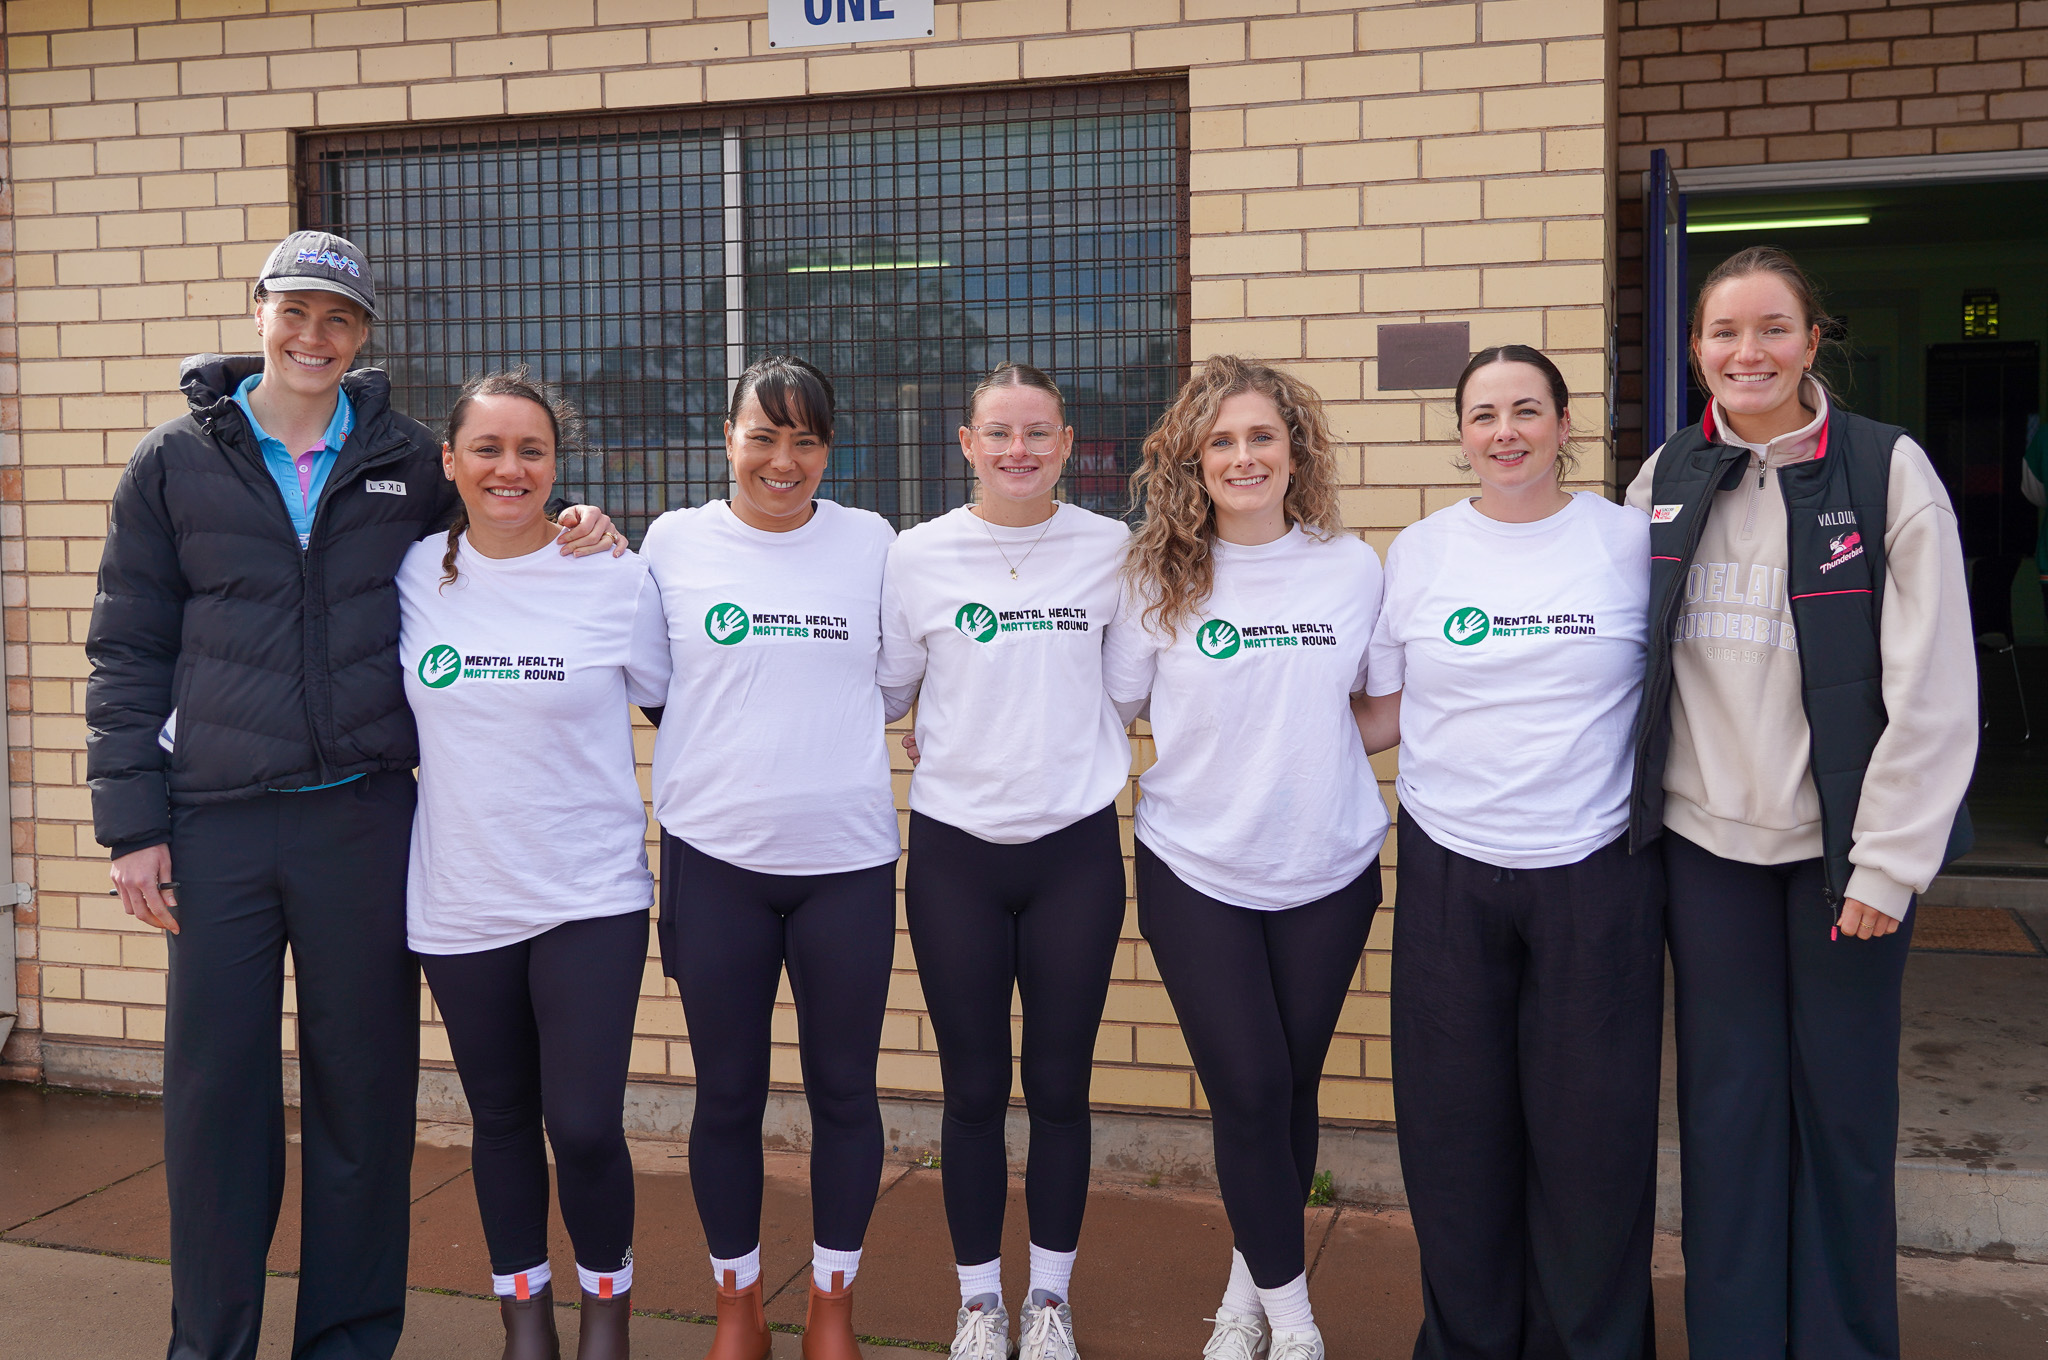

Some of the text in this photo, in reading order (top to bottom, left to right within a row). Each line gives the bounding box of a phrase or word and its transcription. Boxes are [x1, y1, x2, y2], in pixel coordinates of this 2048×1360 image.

[296, 248, 360, 278] MAVS
[1682, 562, 1791, 613] DELAI
[752, 613, 847, 628] MENTAL HEALTH
[999, 607, 1087, 621] MENTAL HEALTH
[1493, 613, 1594, 626] MENTAL HEALTH
[752, 625, 849, 641] MATTERS ROUND
[1000, 620, 1089, 633] MATTERS ROUND
[1242, 623, 1333, 637] MENTAL HEALTH
[1492, 625, 1596, 637] MATTERS ROUND
[1673, 612, 1797, 652] HUNDERBIR
[1243, 635, 1337, 649] MATTERS ROUND
[465, 655, 564, 668] MENTAL HEALTH
[1706, 646, 1766, 665] SINCE 1997
[463, 668, 565, 682] MATTERS ROUND
